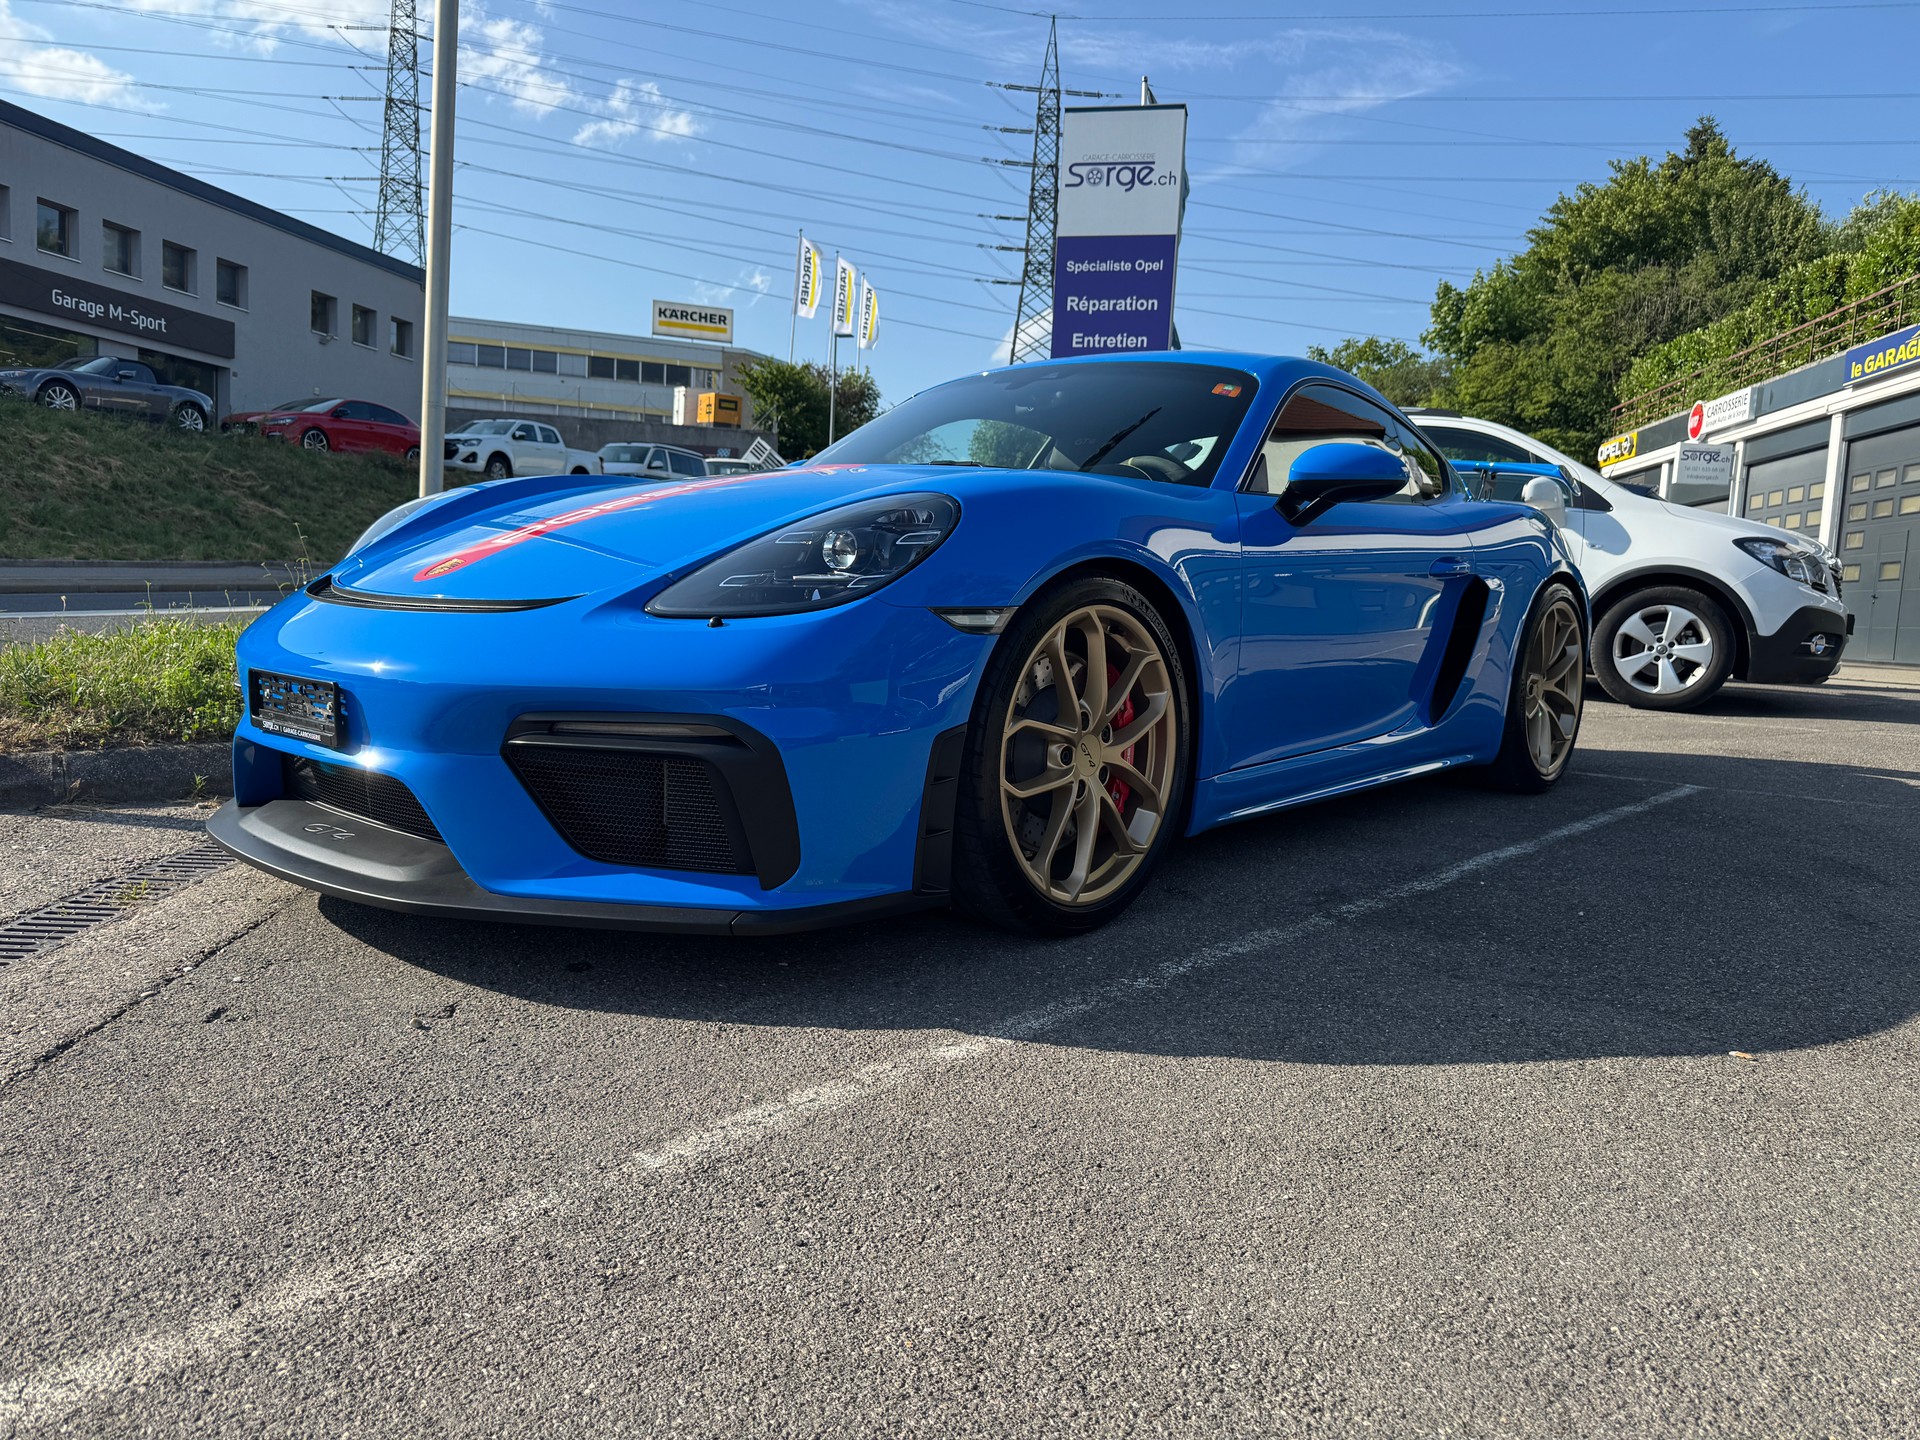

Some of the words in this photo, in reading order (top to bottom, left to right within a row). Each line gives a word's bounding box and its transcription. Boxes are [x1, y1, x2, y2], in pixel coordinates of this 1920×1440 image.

[1066, 260, 1131, 273] Spécialiste
[1135, 259, 1164, 272] Opel
[52, 289, 104, 318] Garage
[109, 303, 167, 332] M-Sport
[1066, 296, 1158, 314] Réparation
[658, 307, 727, 325] KÄRCHER
[1072, 333, 1147, 348] Entretien
[1850, 361, 1862, 379] le
[1706, 392, 1748, 418] CARROSSERIE
[1597, 441, 1621, 462] OPEL
[1080, 742, 1096, 768] GT4
[302, 823, 356, 841] GT4
